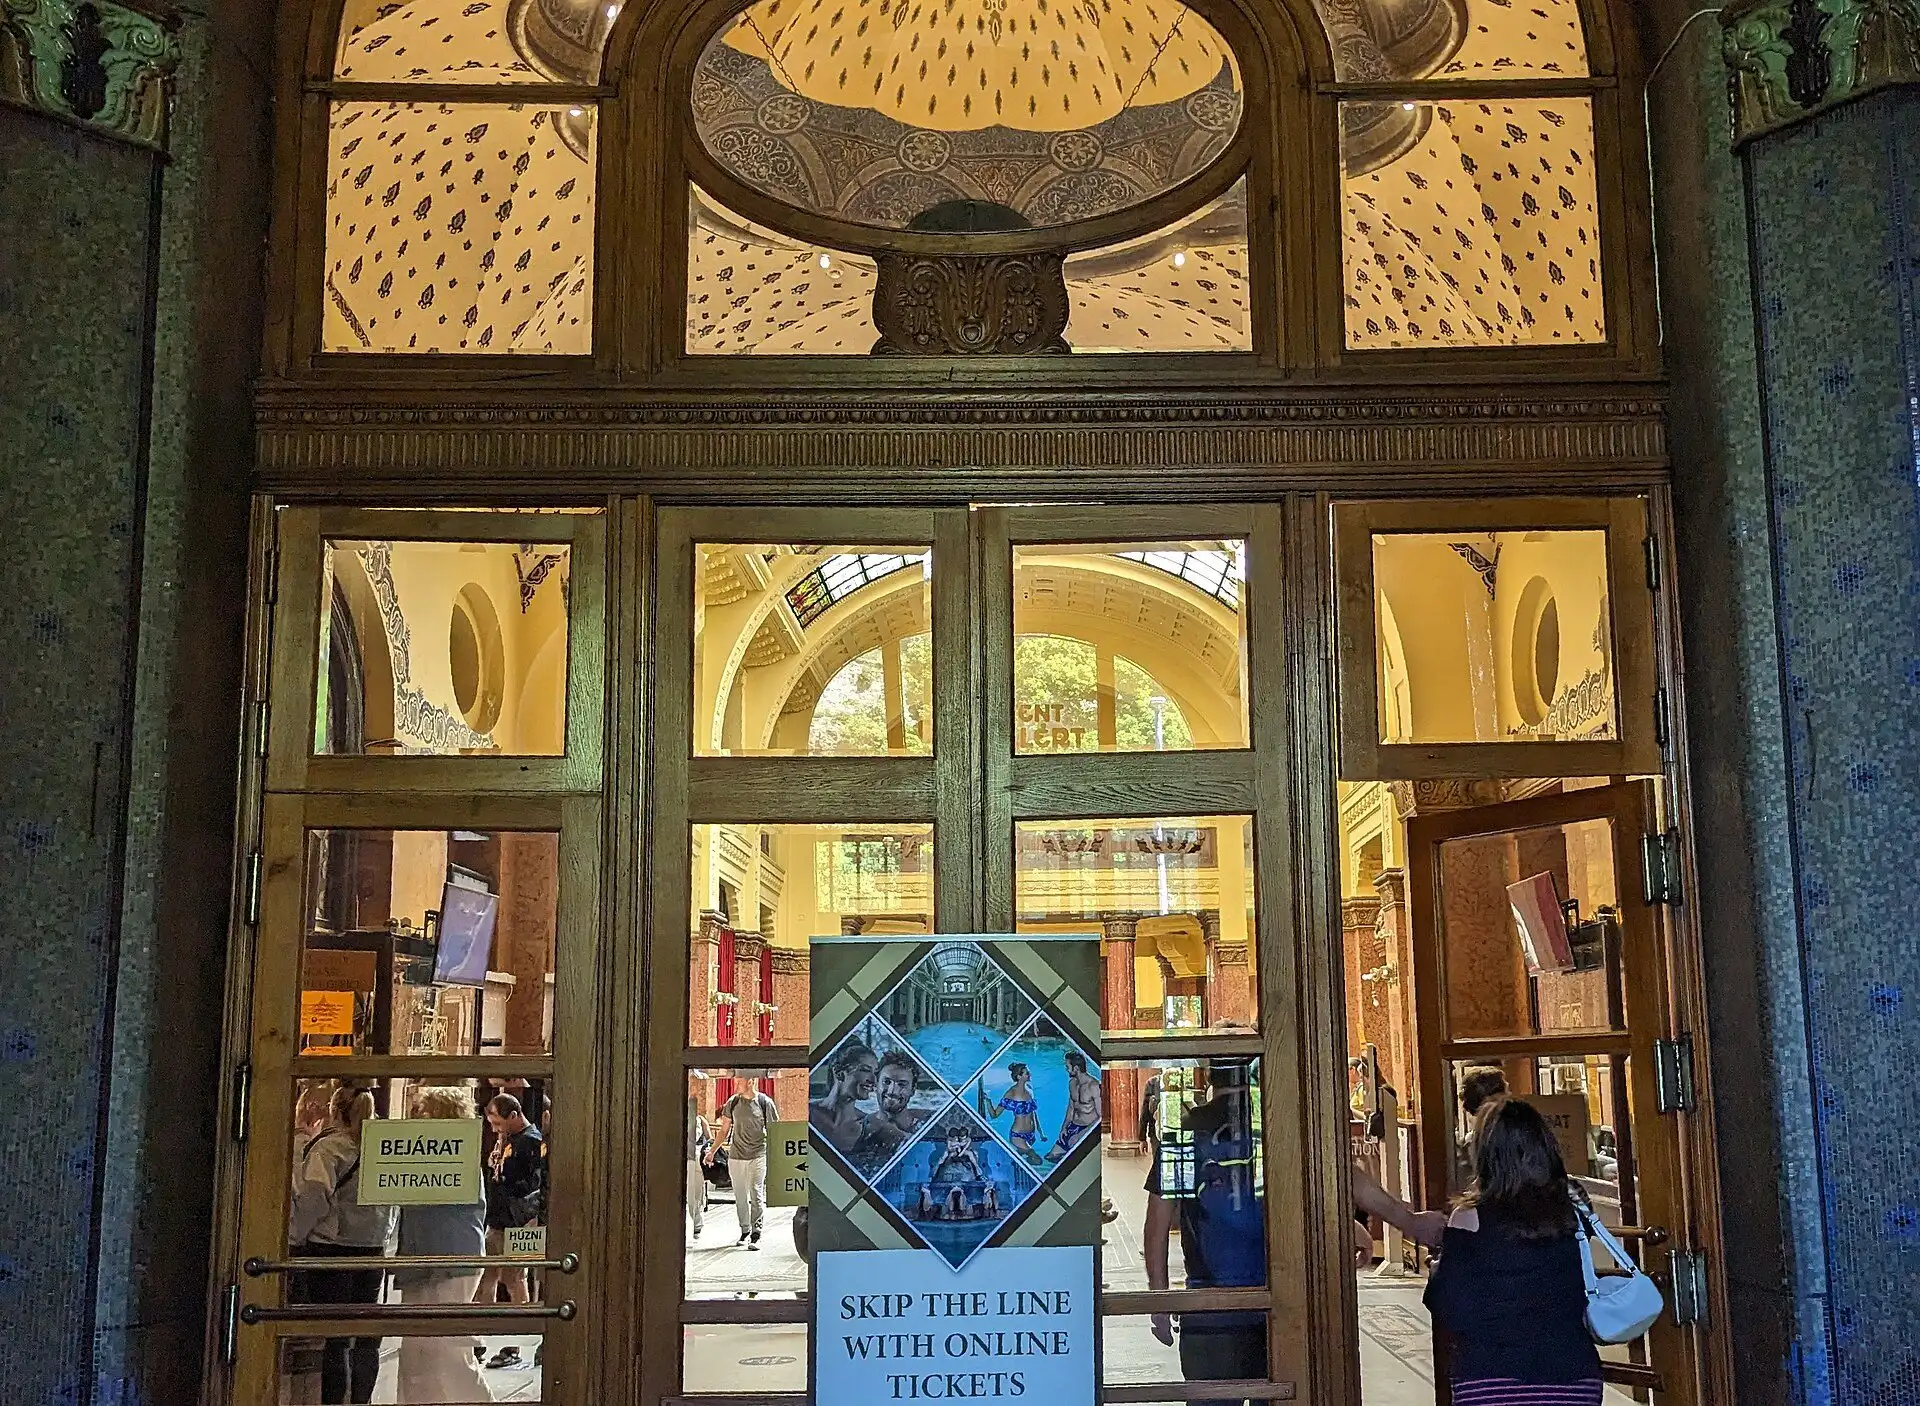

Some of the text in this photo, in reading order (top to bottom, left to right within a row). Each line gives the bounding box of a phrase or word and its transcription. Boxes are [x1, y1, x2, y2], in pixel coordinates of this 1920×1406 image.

[380, 1135, 463, 1156] BEJÁRAT
[1351, 1143, 1380, 1156] TION
[378, 1173, 462, 1188] ENTRANCE
[509, 1229, 542, 1241] HÚZNI
[511, 1242, 538, 1252] PULL
[840, 1291, 1072, 1320] SKIP THE LINE
[842, 1331, 1071, 1360] WITH ONLINE
[886, 1372, 1026, 1399] TICKETS
